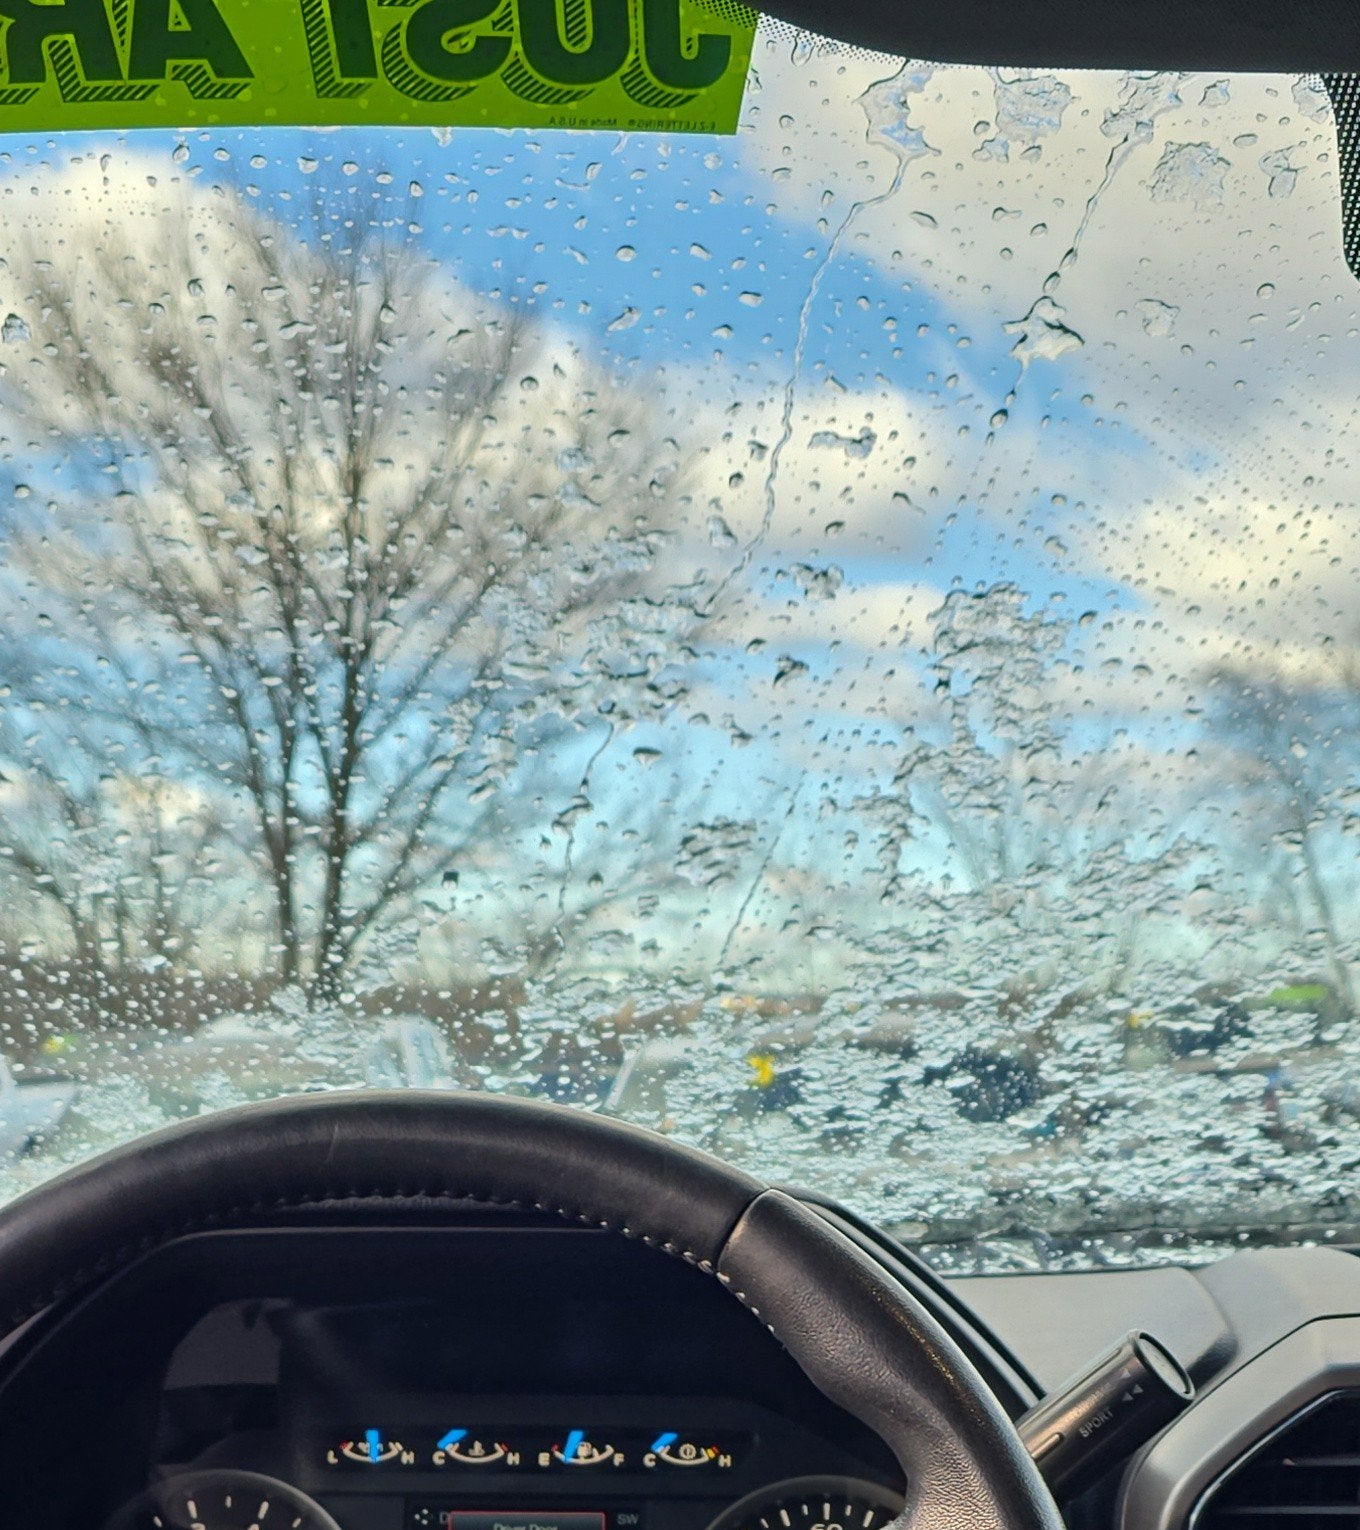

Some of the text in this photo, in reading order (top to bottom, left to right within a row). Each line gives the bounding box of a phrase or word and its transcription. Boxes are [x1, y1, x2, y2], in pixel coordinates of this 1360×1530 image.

[1078, 1407, 1114, 1438] SPORT
[327, 1450, 415, 1465] L H
[432, 1451, 520, 1466] C H
[538, 1451, 624, 1466] E F
[643, 1451, 731, 1467] C H
